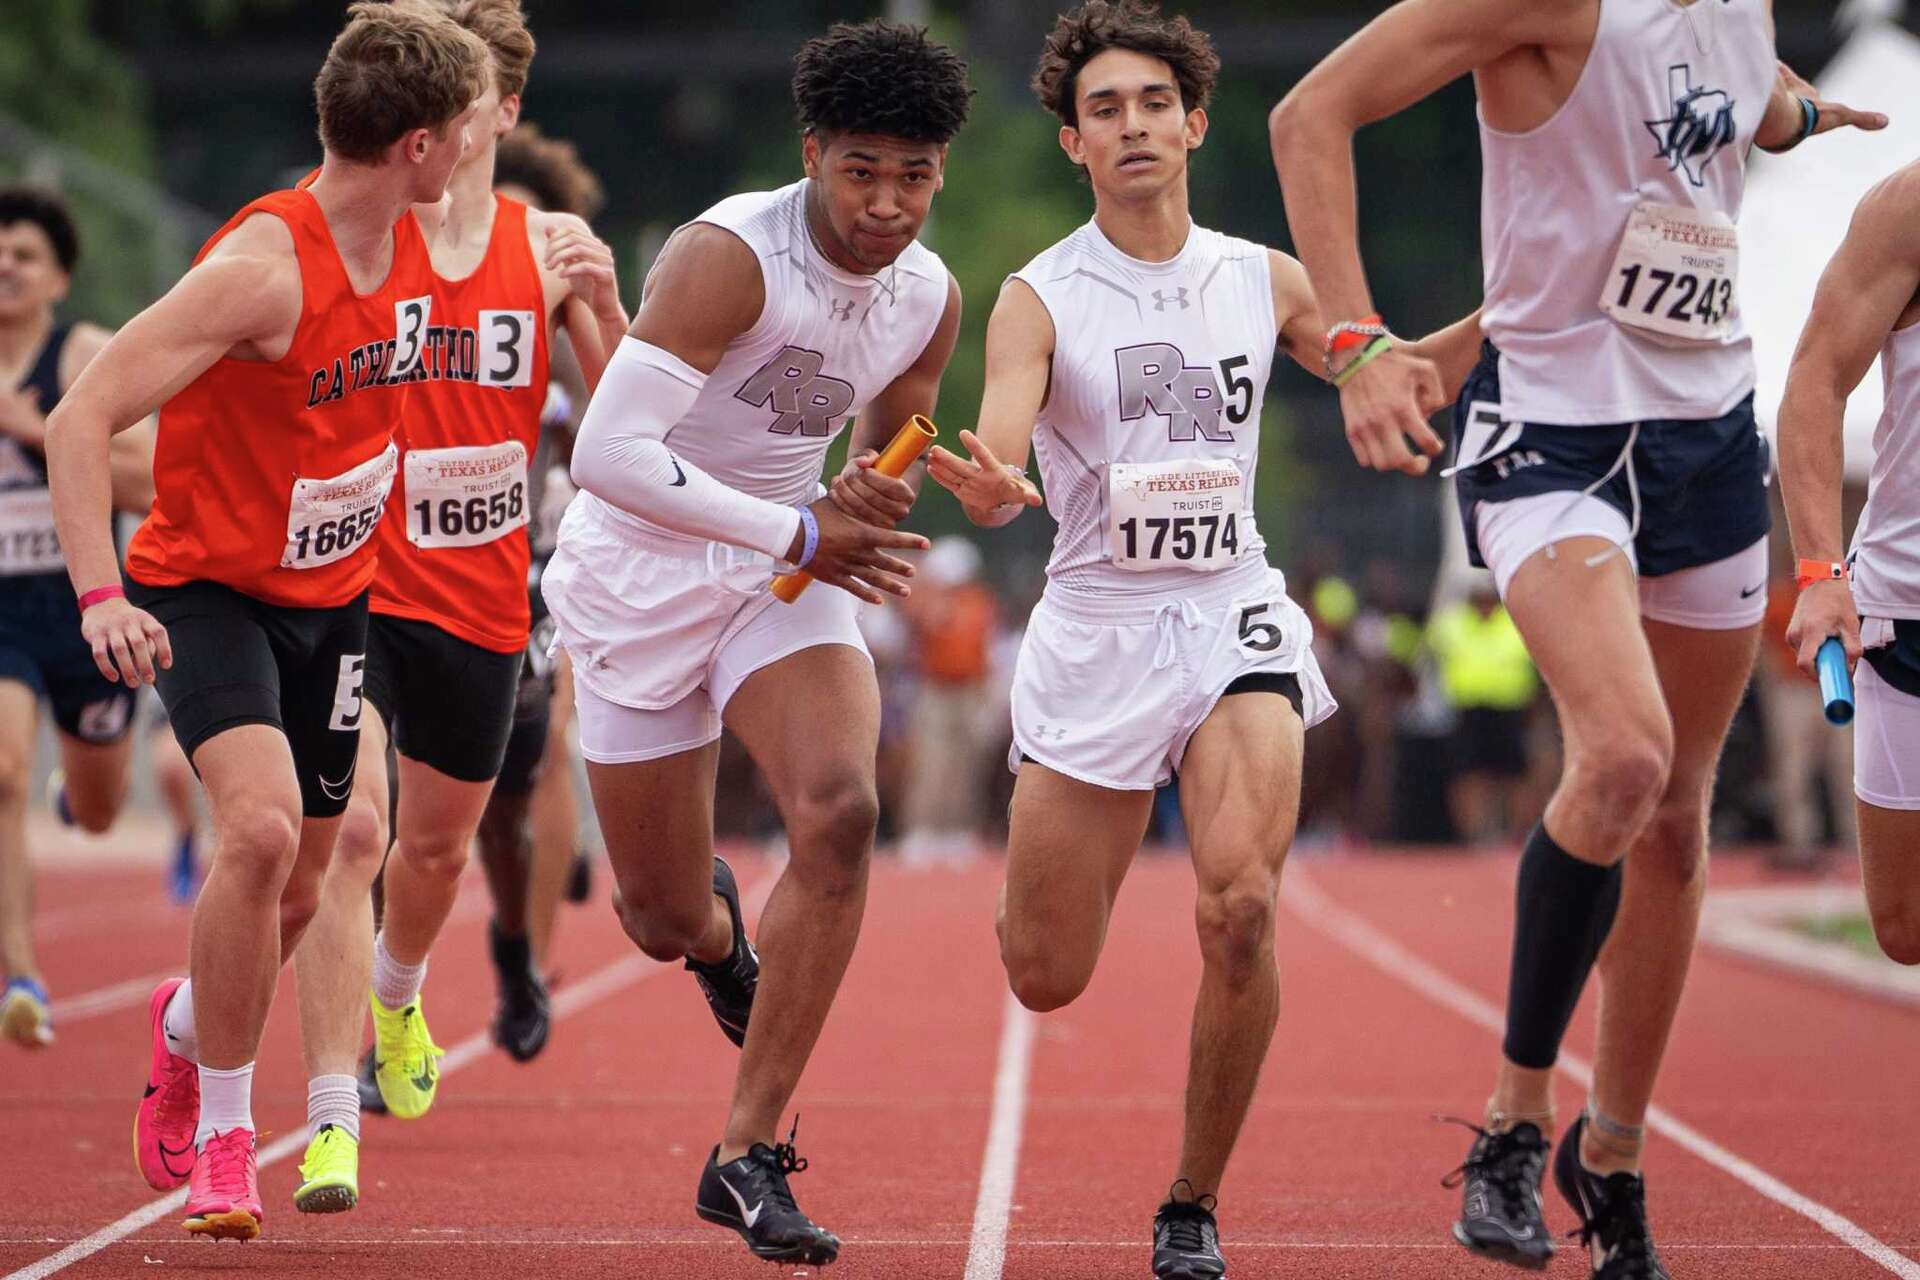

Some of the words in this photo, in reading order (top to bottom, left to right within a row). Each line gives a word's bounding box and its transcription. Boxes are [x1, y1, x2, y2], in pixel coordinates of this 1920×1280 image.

[1617, 263, 1732, 325] 17243
[397, 303, 423, 371] 3
[489, 315, 521, 382] 3
[734, 344, 855, 437] RR
[1114, 342, 1235, 442] RR
[1218, 354, 1254, 425] 5
[1476, 411, 1511, 460] 7
[439, 466, 486, 478] TEXAS
[463, 480, 498, 493] TRUIST
[1146, 479, 1195, 492] TEXAS
[1199, 475, 1240, 489] RELAYS
[414, 481, 523, 536] 16658
[1172, 500, 1210, 511] TRUIST
[1119, 513, 1238, 560] 17574
[1238, 602, 1282, 652] 5
